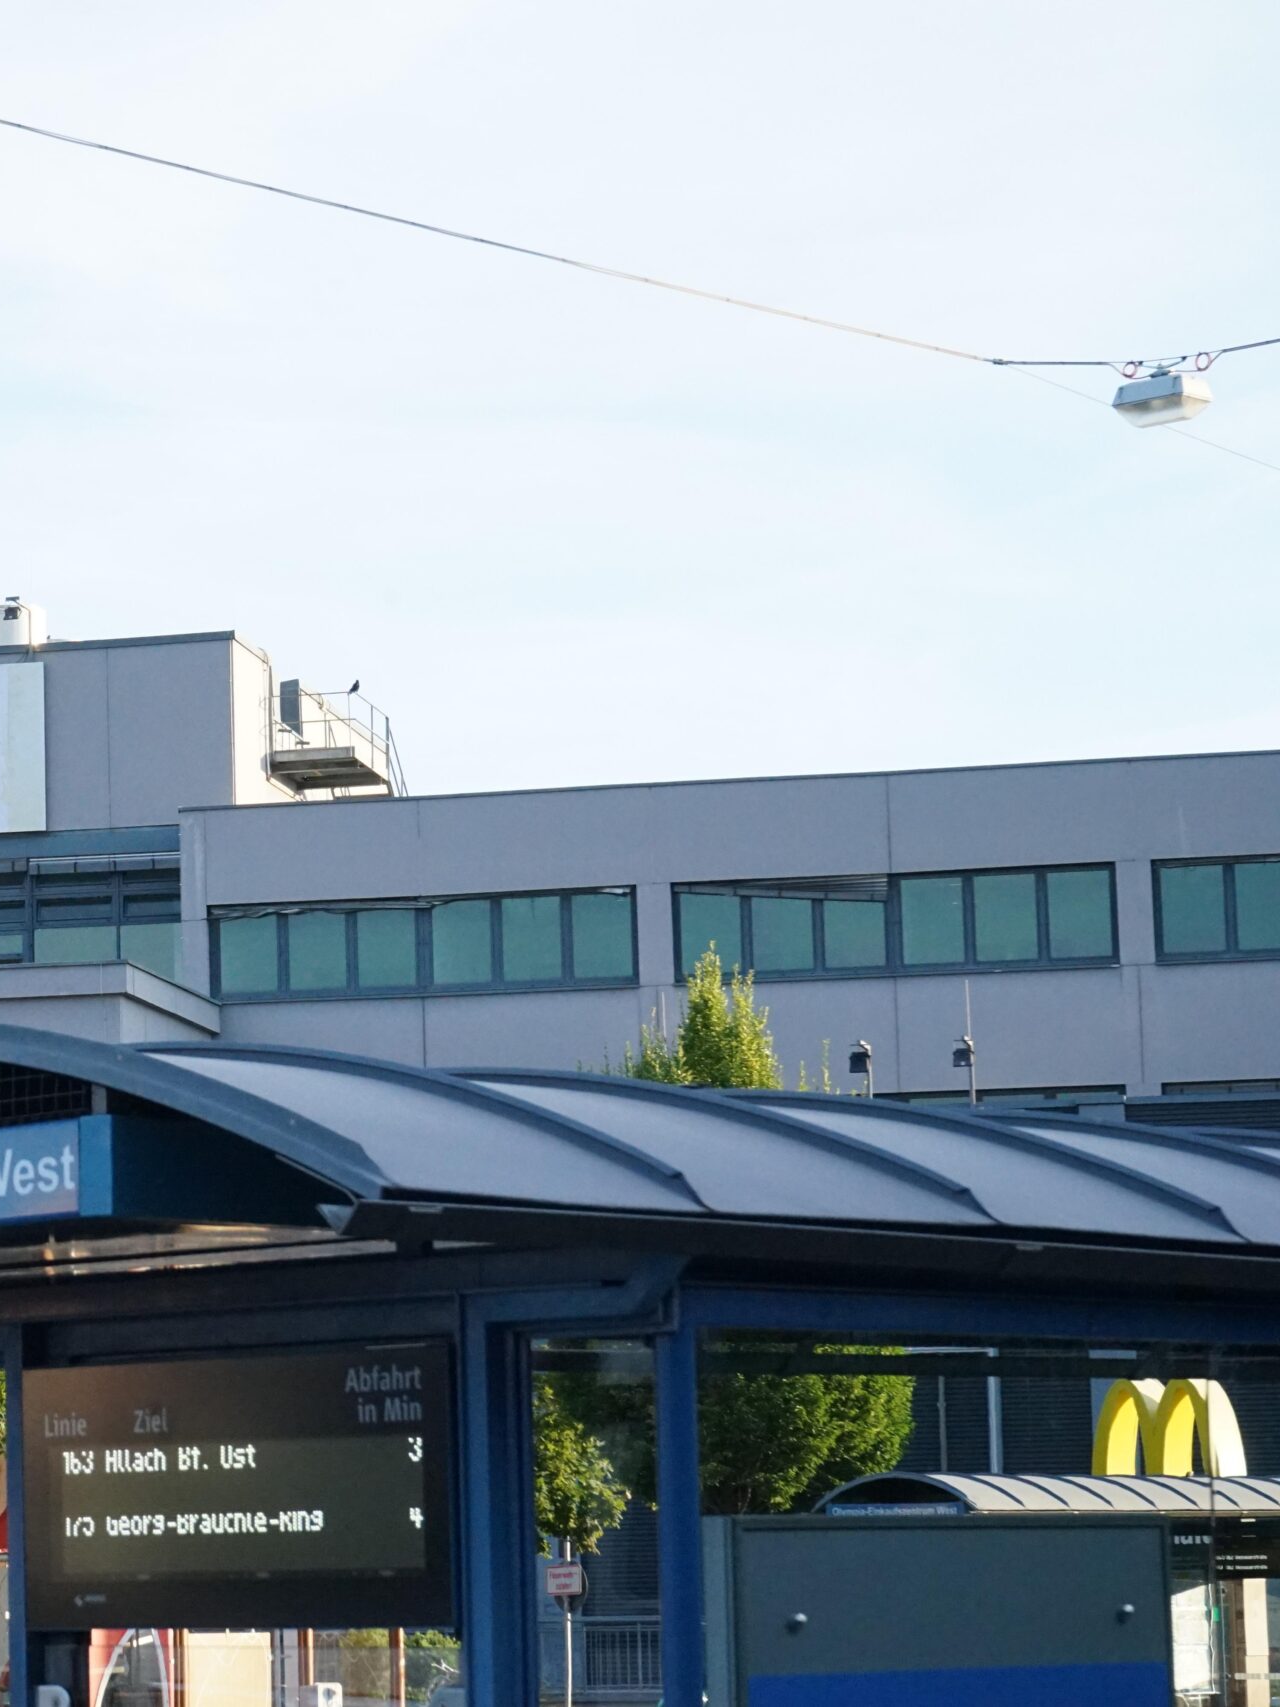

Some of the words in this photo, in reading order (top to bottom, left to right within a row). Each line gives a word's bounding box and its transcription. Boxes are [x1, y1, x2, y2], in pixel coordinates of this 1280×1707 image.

[344, 1363, 422, 1393] Abfahrt
[44, 1411, 88, 1438] Linie
[133, 1408, 169, 1433] Ziel
[357, 1397, 377, 1423] in
[383, 1394, 423, 1422] Min
[62, 1450, 95, 1476] 163
